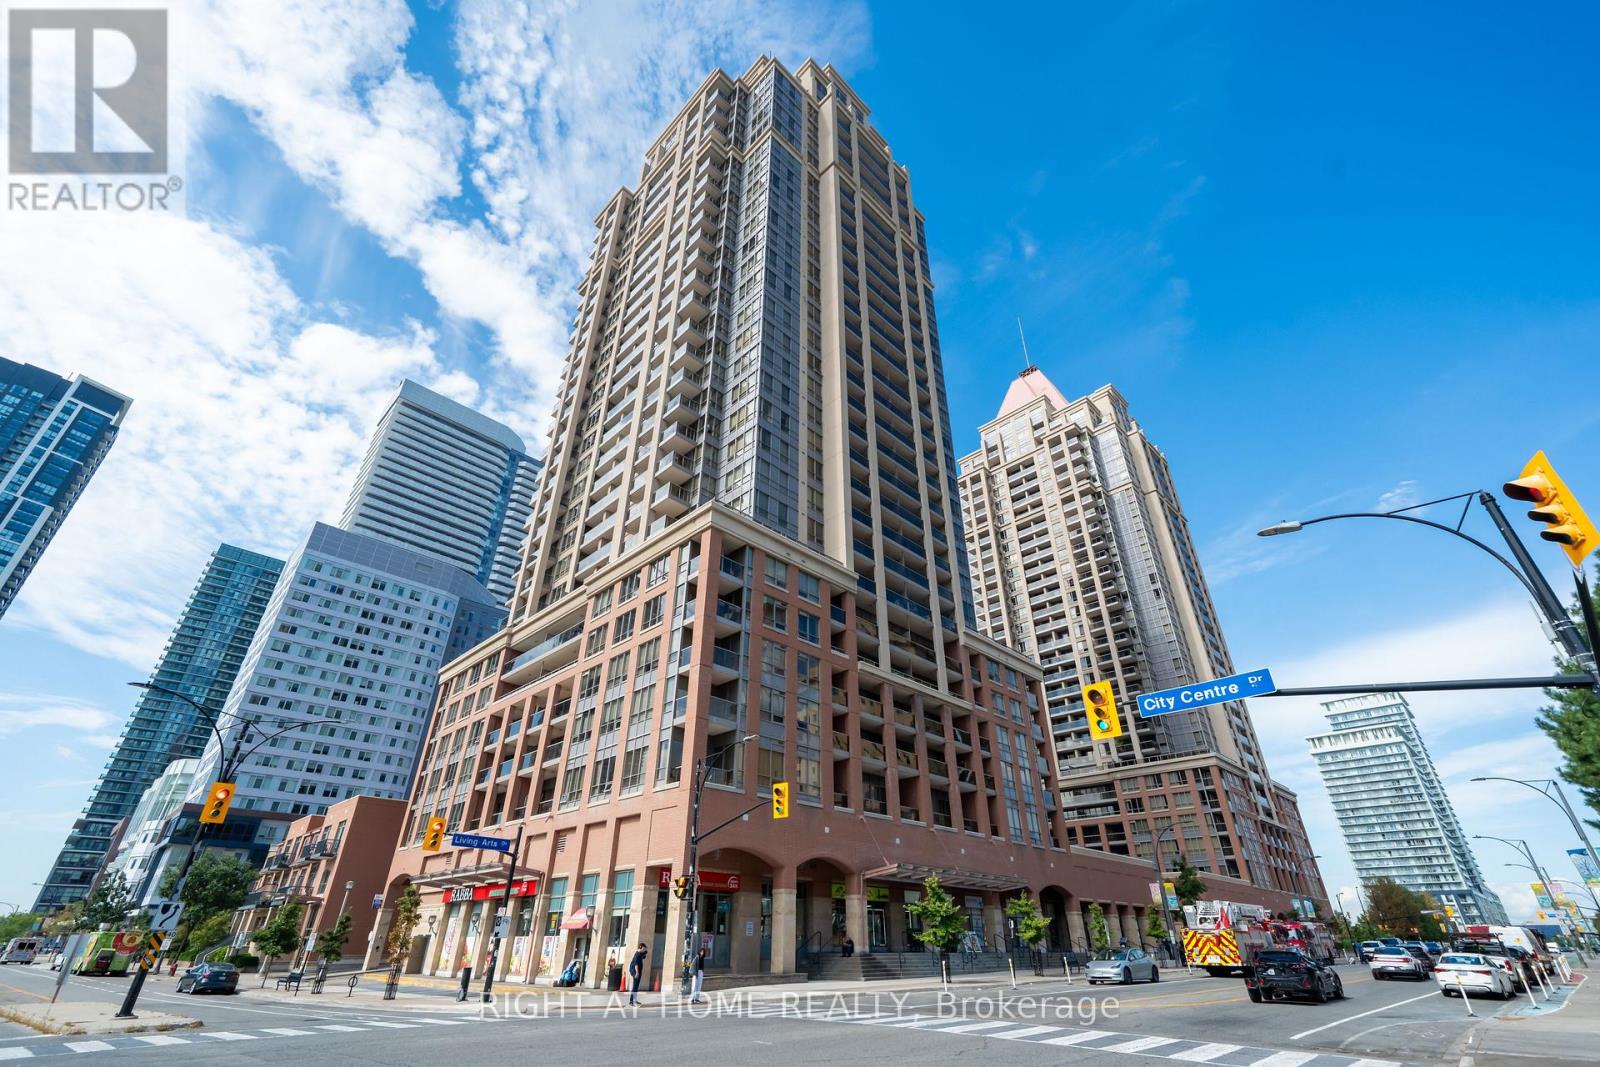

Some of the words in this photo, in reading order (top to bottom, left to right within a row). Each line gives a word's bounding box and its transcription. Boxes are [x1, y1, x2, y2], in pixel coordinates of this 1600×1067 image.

[1144, 696, 1174, 710] City
[1181, 684, 1239, 703] Centre
[1247, 675, 1263, 684] Dr
[454, 836, 479, 847] Living
[481, 838, 498, 847] Arts
